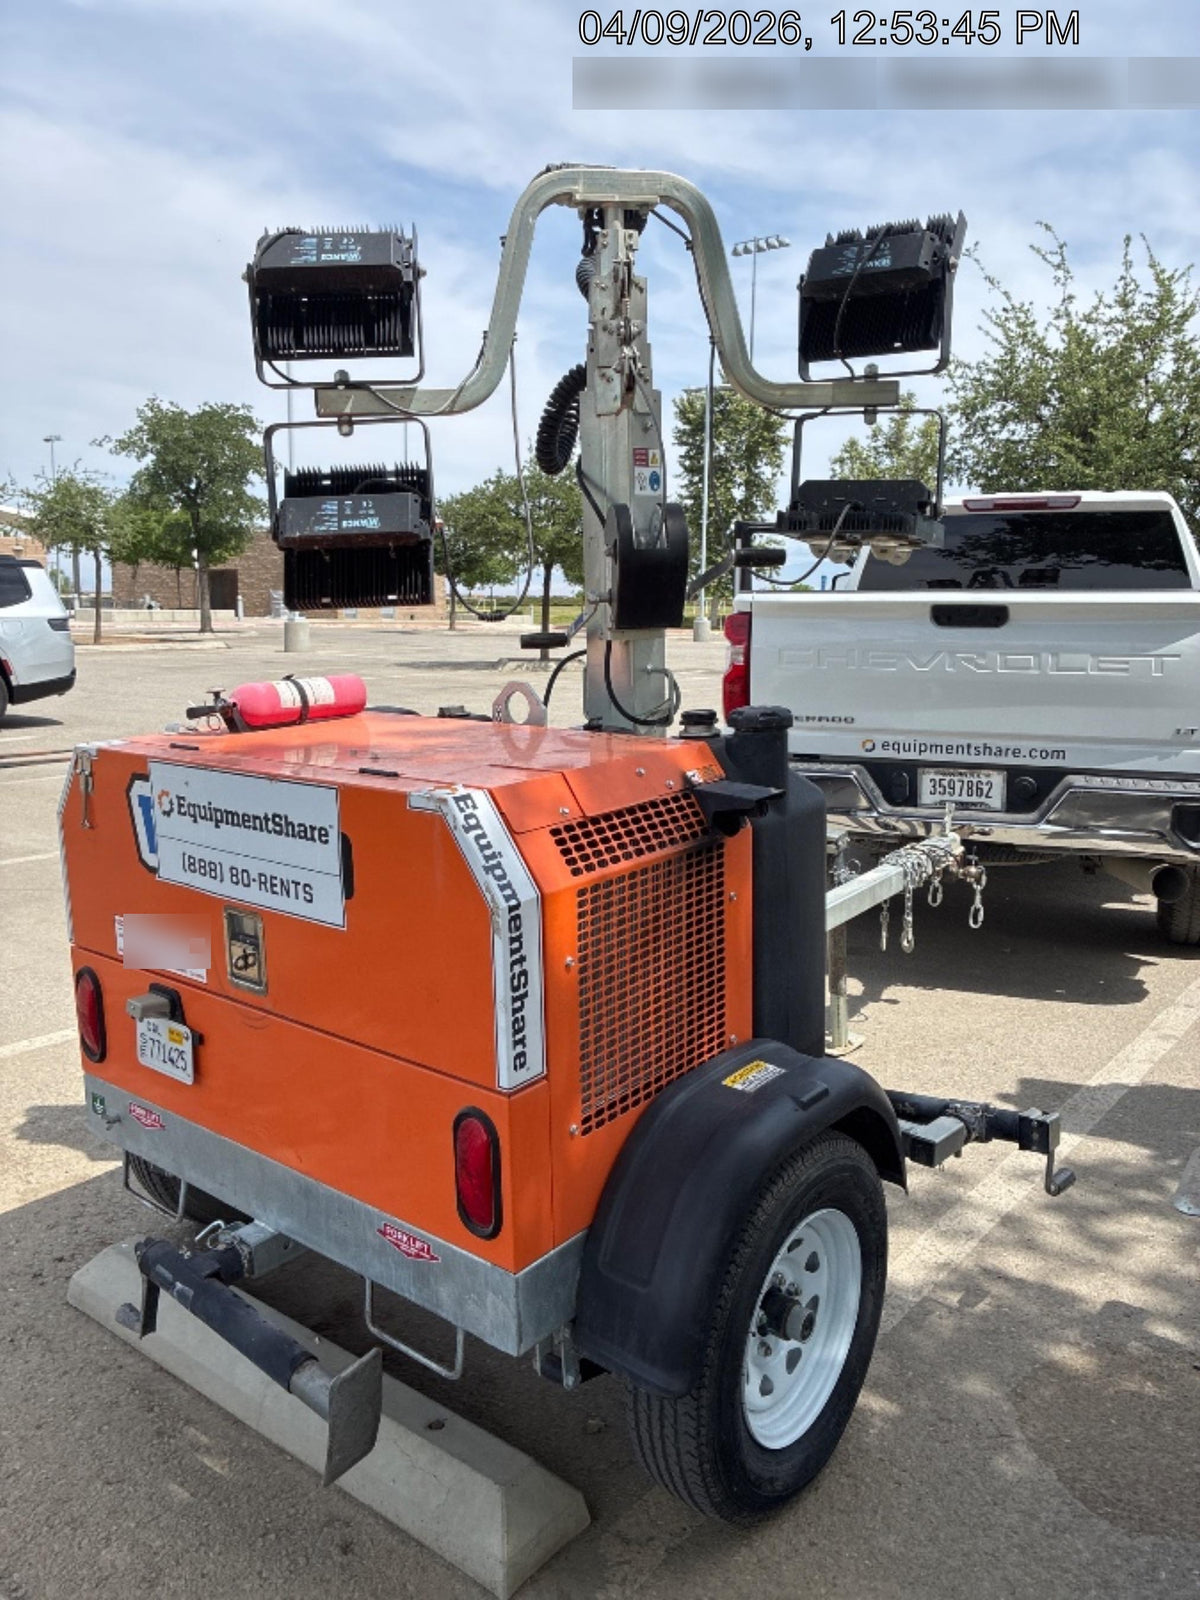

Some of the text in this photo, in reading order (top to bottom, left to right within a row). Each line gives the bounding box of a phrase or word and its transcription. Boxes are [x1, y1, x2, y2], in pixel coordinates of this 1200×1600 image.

[777, 648, 1182, 676] CHEVROLET
[793, 715, 856, 724] ERADO
[881, 738, 1067, 761] equipmentshare.com
[929, 778, 993, 799] 3597862
[176, 795, 330, 845] EquipmentShare
[182, 852, 314, 904] (888) 80-RENTS
[453, 793, 529, 1072] EquipmentShare
[149, 1037, 187, 1071] 771425
